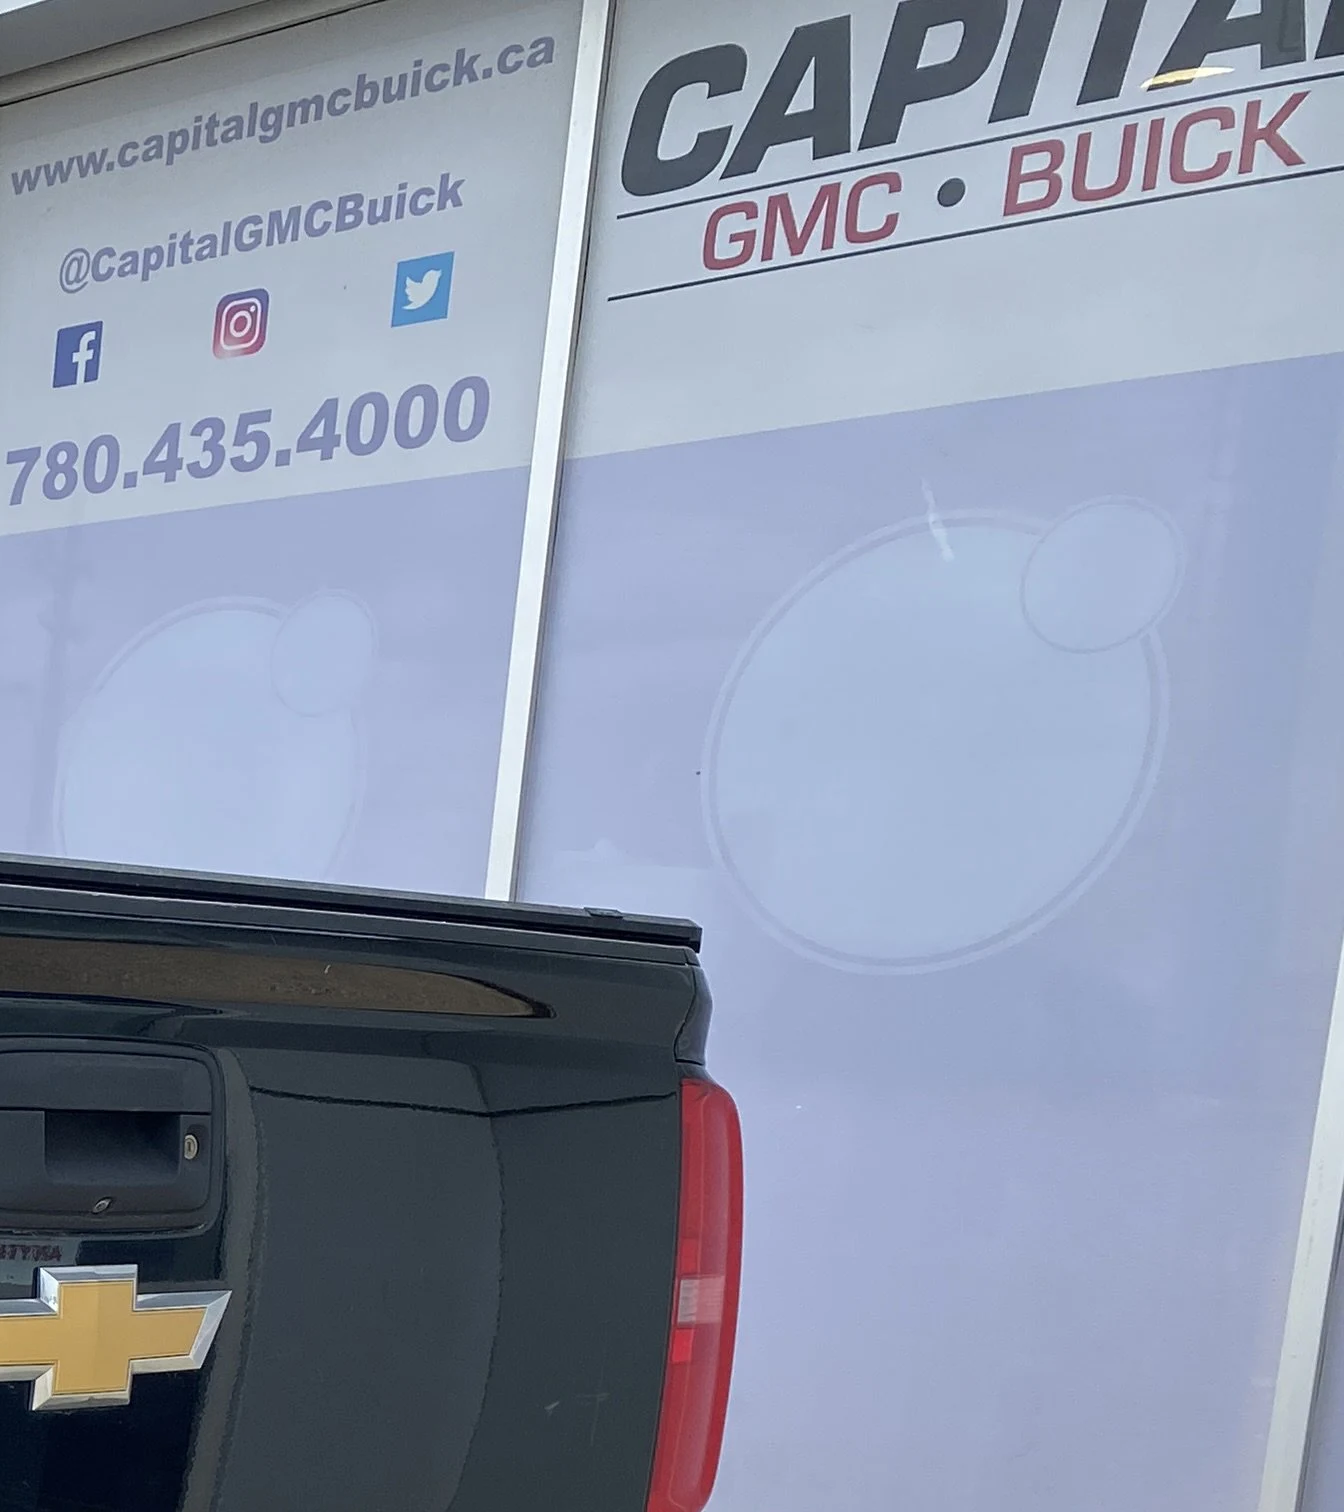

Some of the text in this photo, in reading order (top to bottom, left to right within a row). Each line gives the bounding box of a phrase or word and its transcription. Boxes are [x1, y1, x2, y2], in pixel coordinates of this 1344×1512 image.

[11, 35, 556, 196] www.capitalgmcbuick.ca
[620, 0, 1344, 197] CAPITA
[59, 171, 467, 294] @CapitalGMCBuick
[702, 90, 1311, 271] GMC BUICK
[5, 375, 490, 506] 780.435.4000
